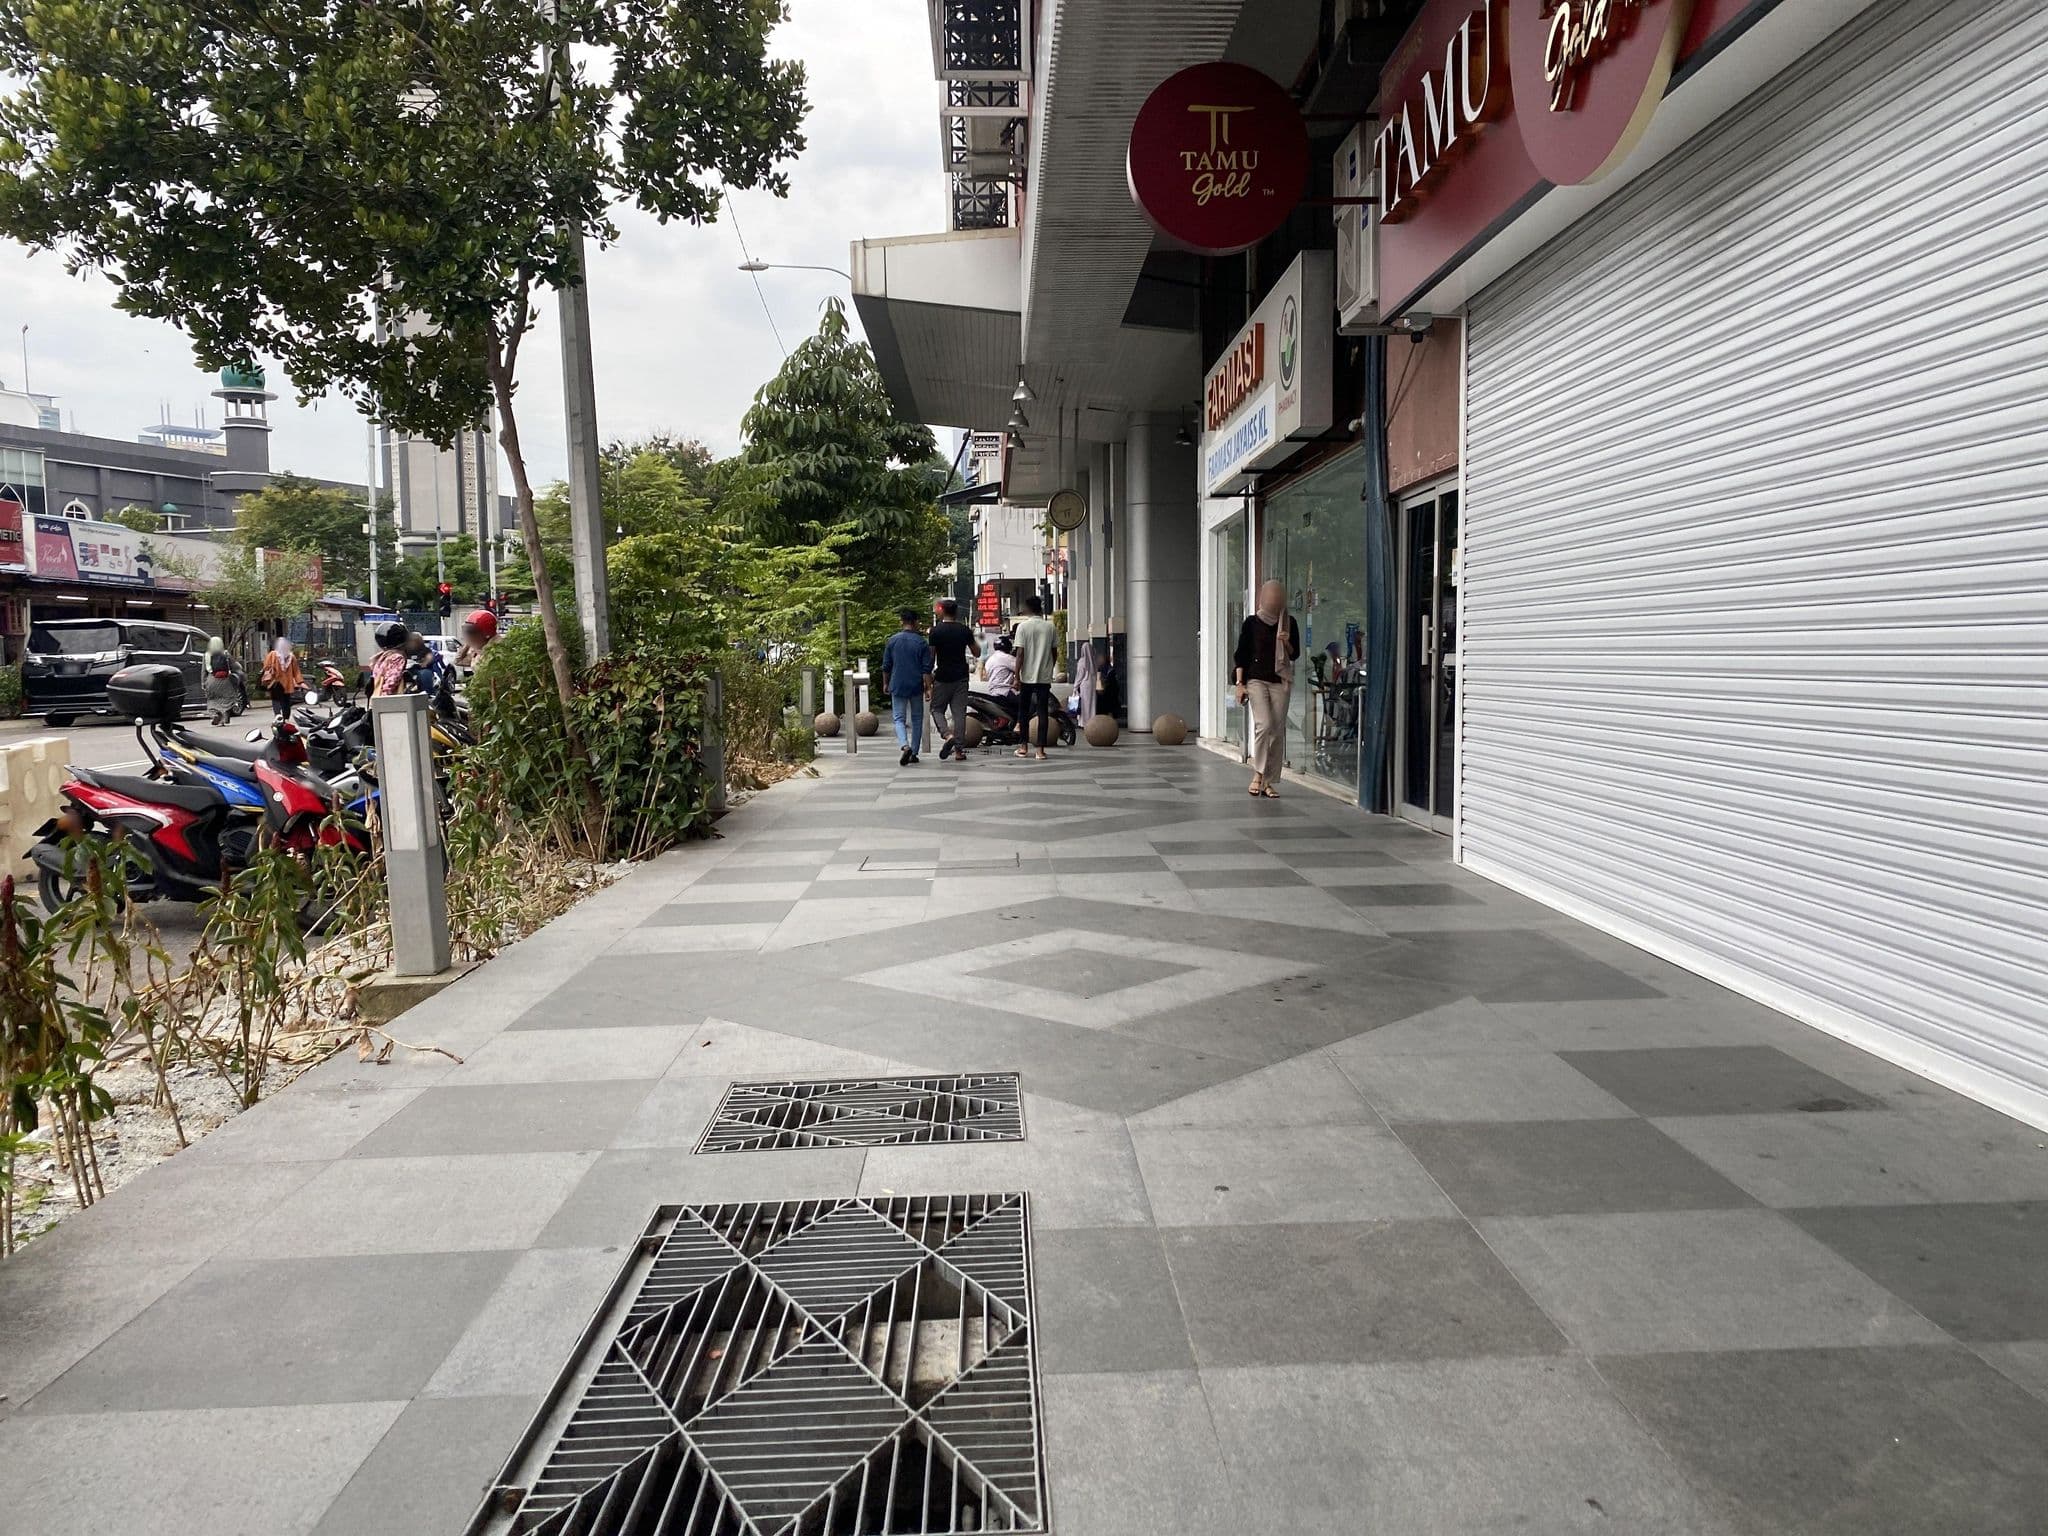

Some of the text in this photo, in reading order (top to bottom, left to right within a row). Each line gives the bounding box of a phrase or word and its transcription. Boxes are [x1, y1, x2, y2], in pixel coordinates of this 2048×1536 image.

[1374, 0, 1490, 224] TAMU
[1179, 150, 1260, 171] TAMU
[1191, 171, 1251, 206] Gold
[1207, 322, 1263, 431] FARMASI
[1207, 437, 1233, 481] FARMASI
[1258, 405, 1269, 440] KL
